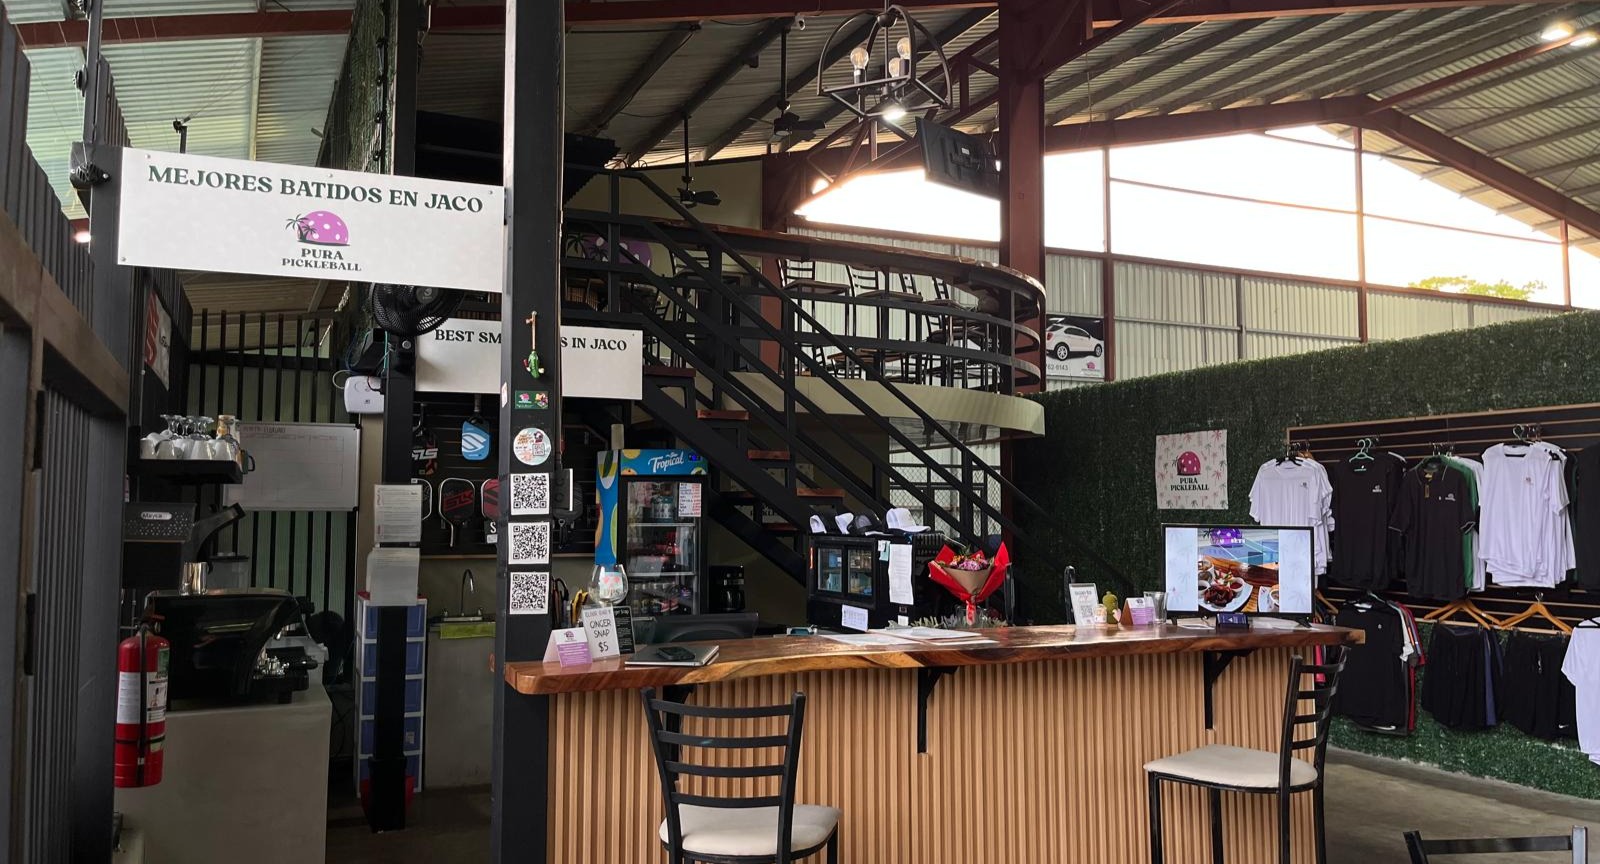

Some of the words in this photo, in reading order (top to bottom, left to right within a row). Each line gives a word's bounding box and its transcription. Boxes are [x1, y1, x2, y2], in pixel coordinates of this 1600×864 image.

[147, 165, 273, 193] MEJORES
[280, 178, 383, 205] BATIDOS
[388, 189, 419, 208] EN
[424, 193, 484, 214] JACO
[300, 248, 344, 261] PURA
[282, 257, 362, 272] PICKLEBALL
[434, 329, 474, 343] BEST
[572, 337, 587, 349] IN
[590, 338, 628, 350] JACO
[648, 451, 684, 473] Tropical
[593, 629, 610, 639] SNAP
[598, 641, 609, 653] $5
